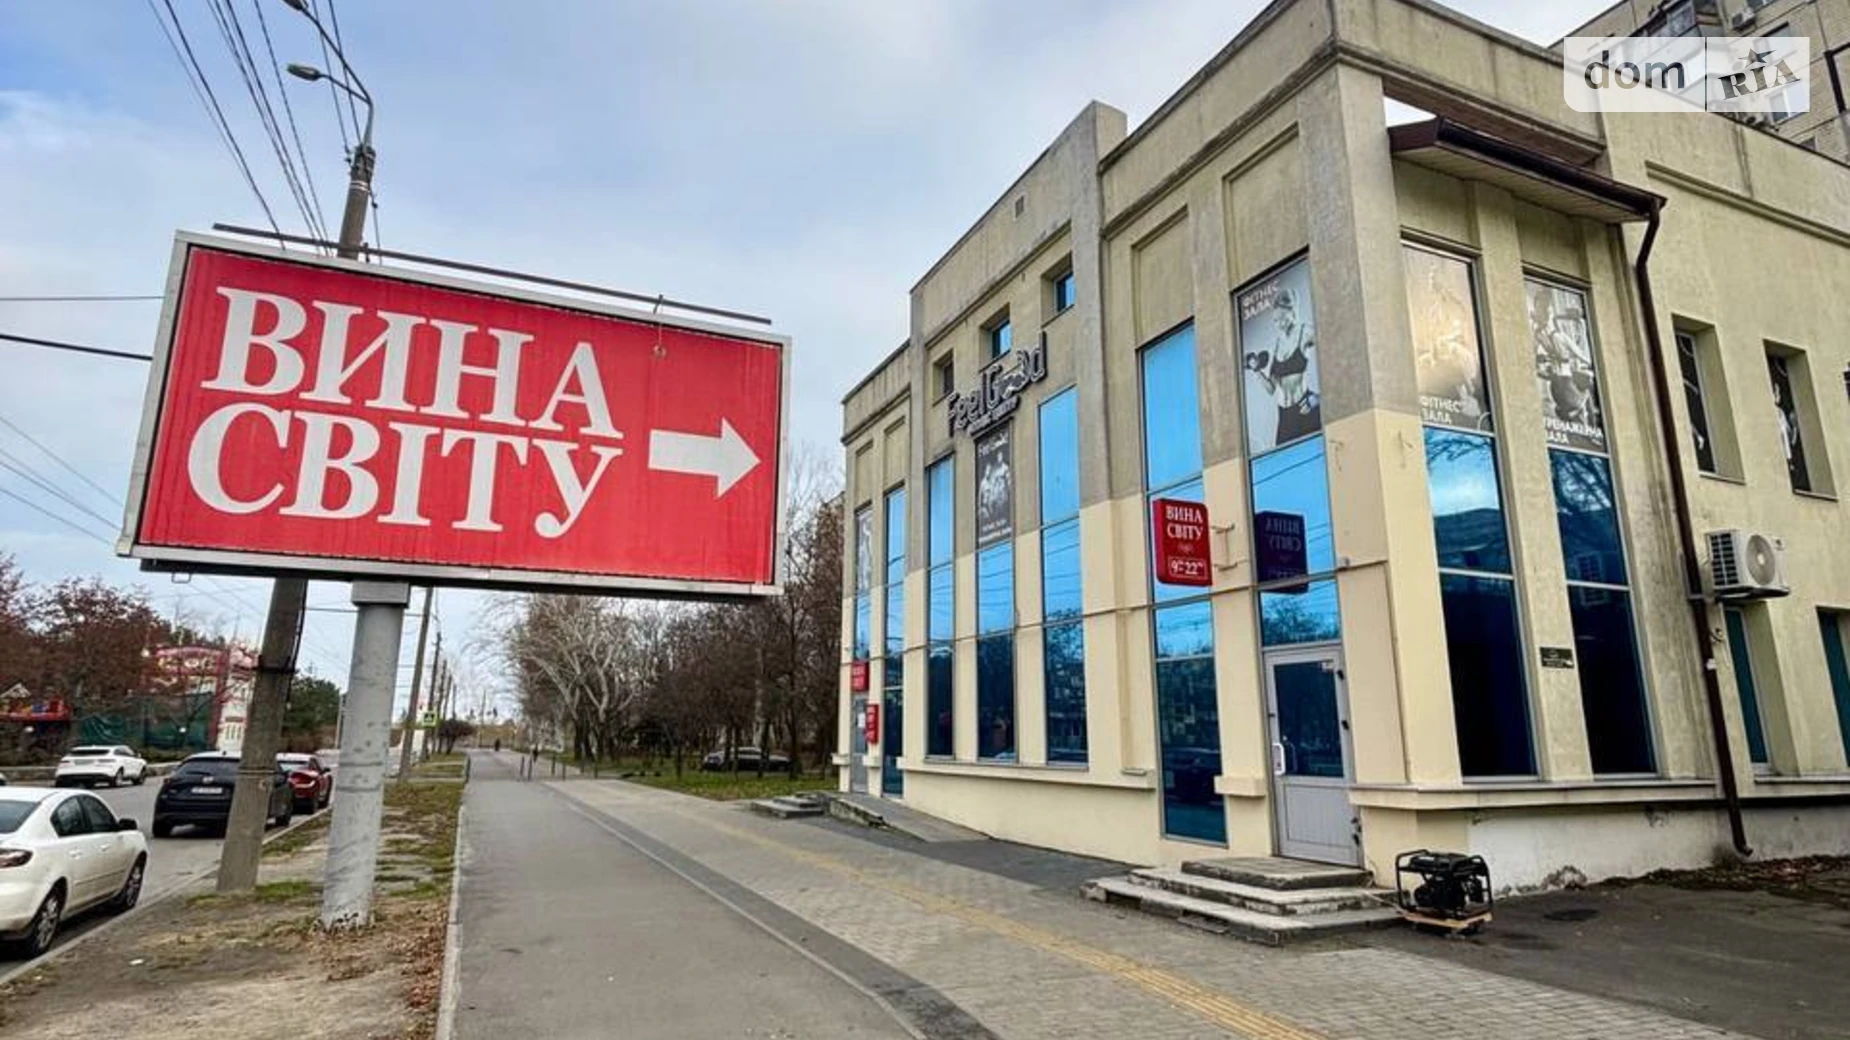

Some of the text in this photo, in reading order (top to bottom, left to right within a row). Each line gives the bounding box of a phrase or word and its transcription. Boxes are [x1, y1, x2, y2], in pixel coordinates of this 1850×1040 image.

[201, 286, 623, 440] ВИНА
[1419, 395, 1462, 413] ФІТНЕС
[187, 401, 623, 540] СВІТУ
[1165, 506, 1203, 524] ВИНА
[1167, 522, 1204, 541] СВІТУ
